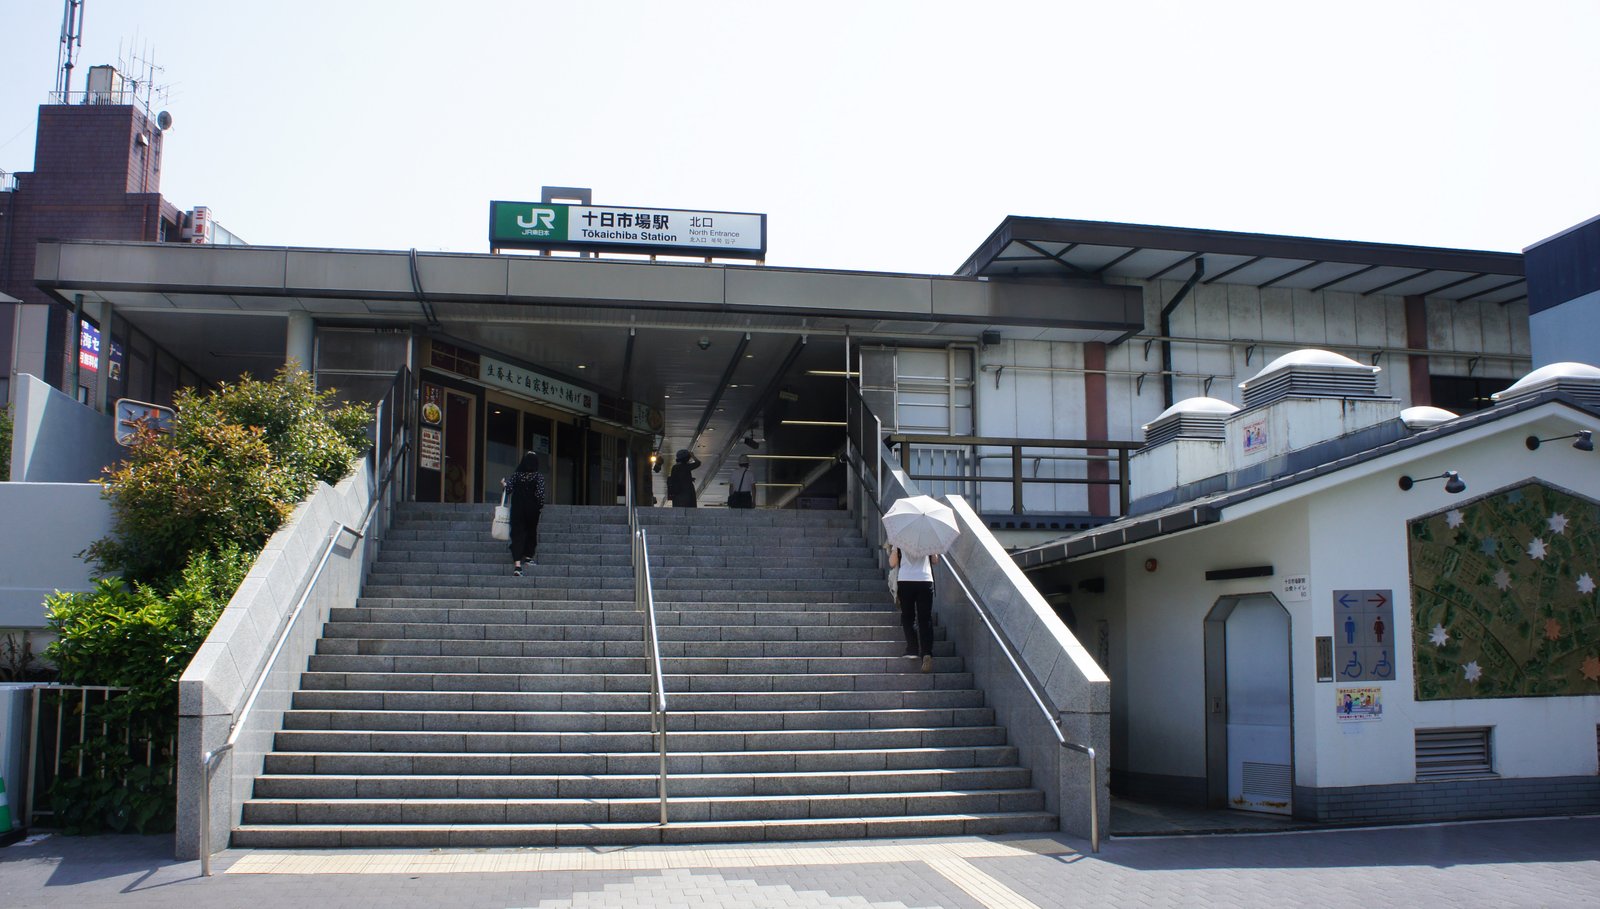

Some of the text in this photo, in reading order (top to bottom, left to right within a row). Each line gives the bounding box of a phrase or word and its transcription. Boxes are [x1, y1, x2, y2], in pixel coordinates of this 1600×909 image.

[517, 208, 555, 229] JR
[582, 211, 669, 230] 十日市場駅
[689, 216, 713, 228] 北口
[582, 228, 677, 242] Tōkaichiba Station
[710, 230, 740, 238] Entrance
